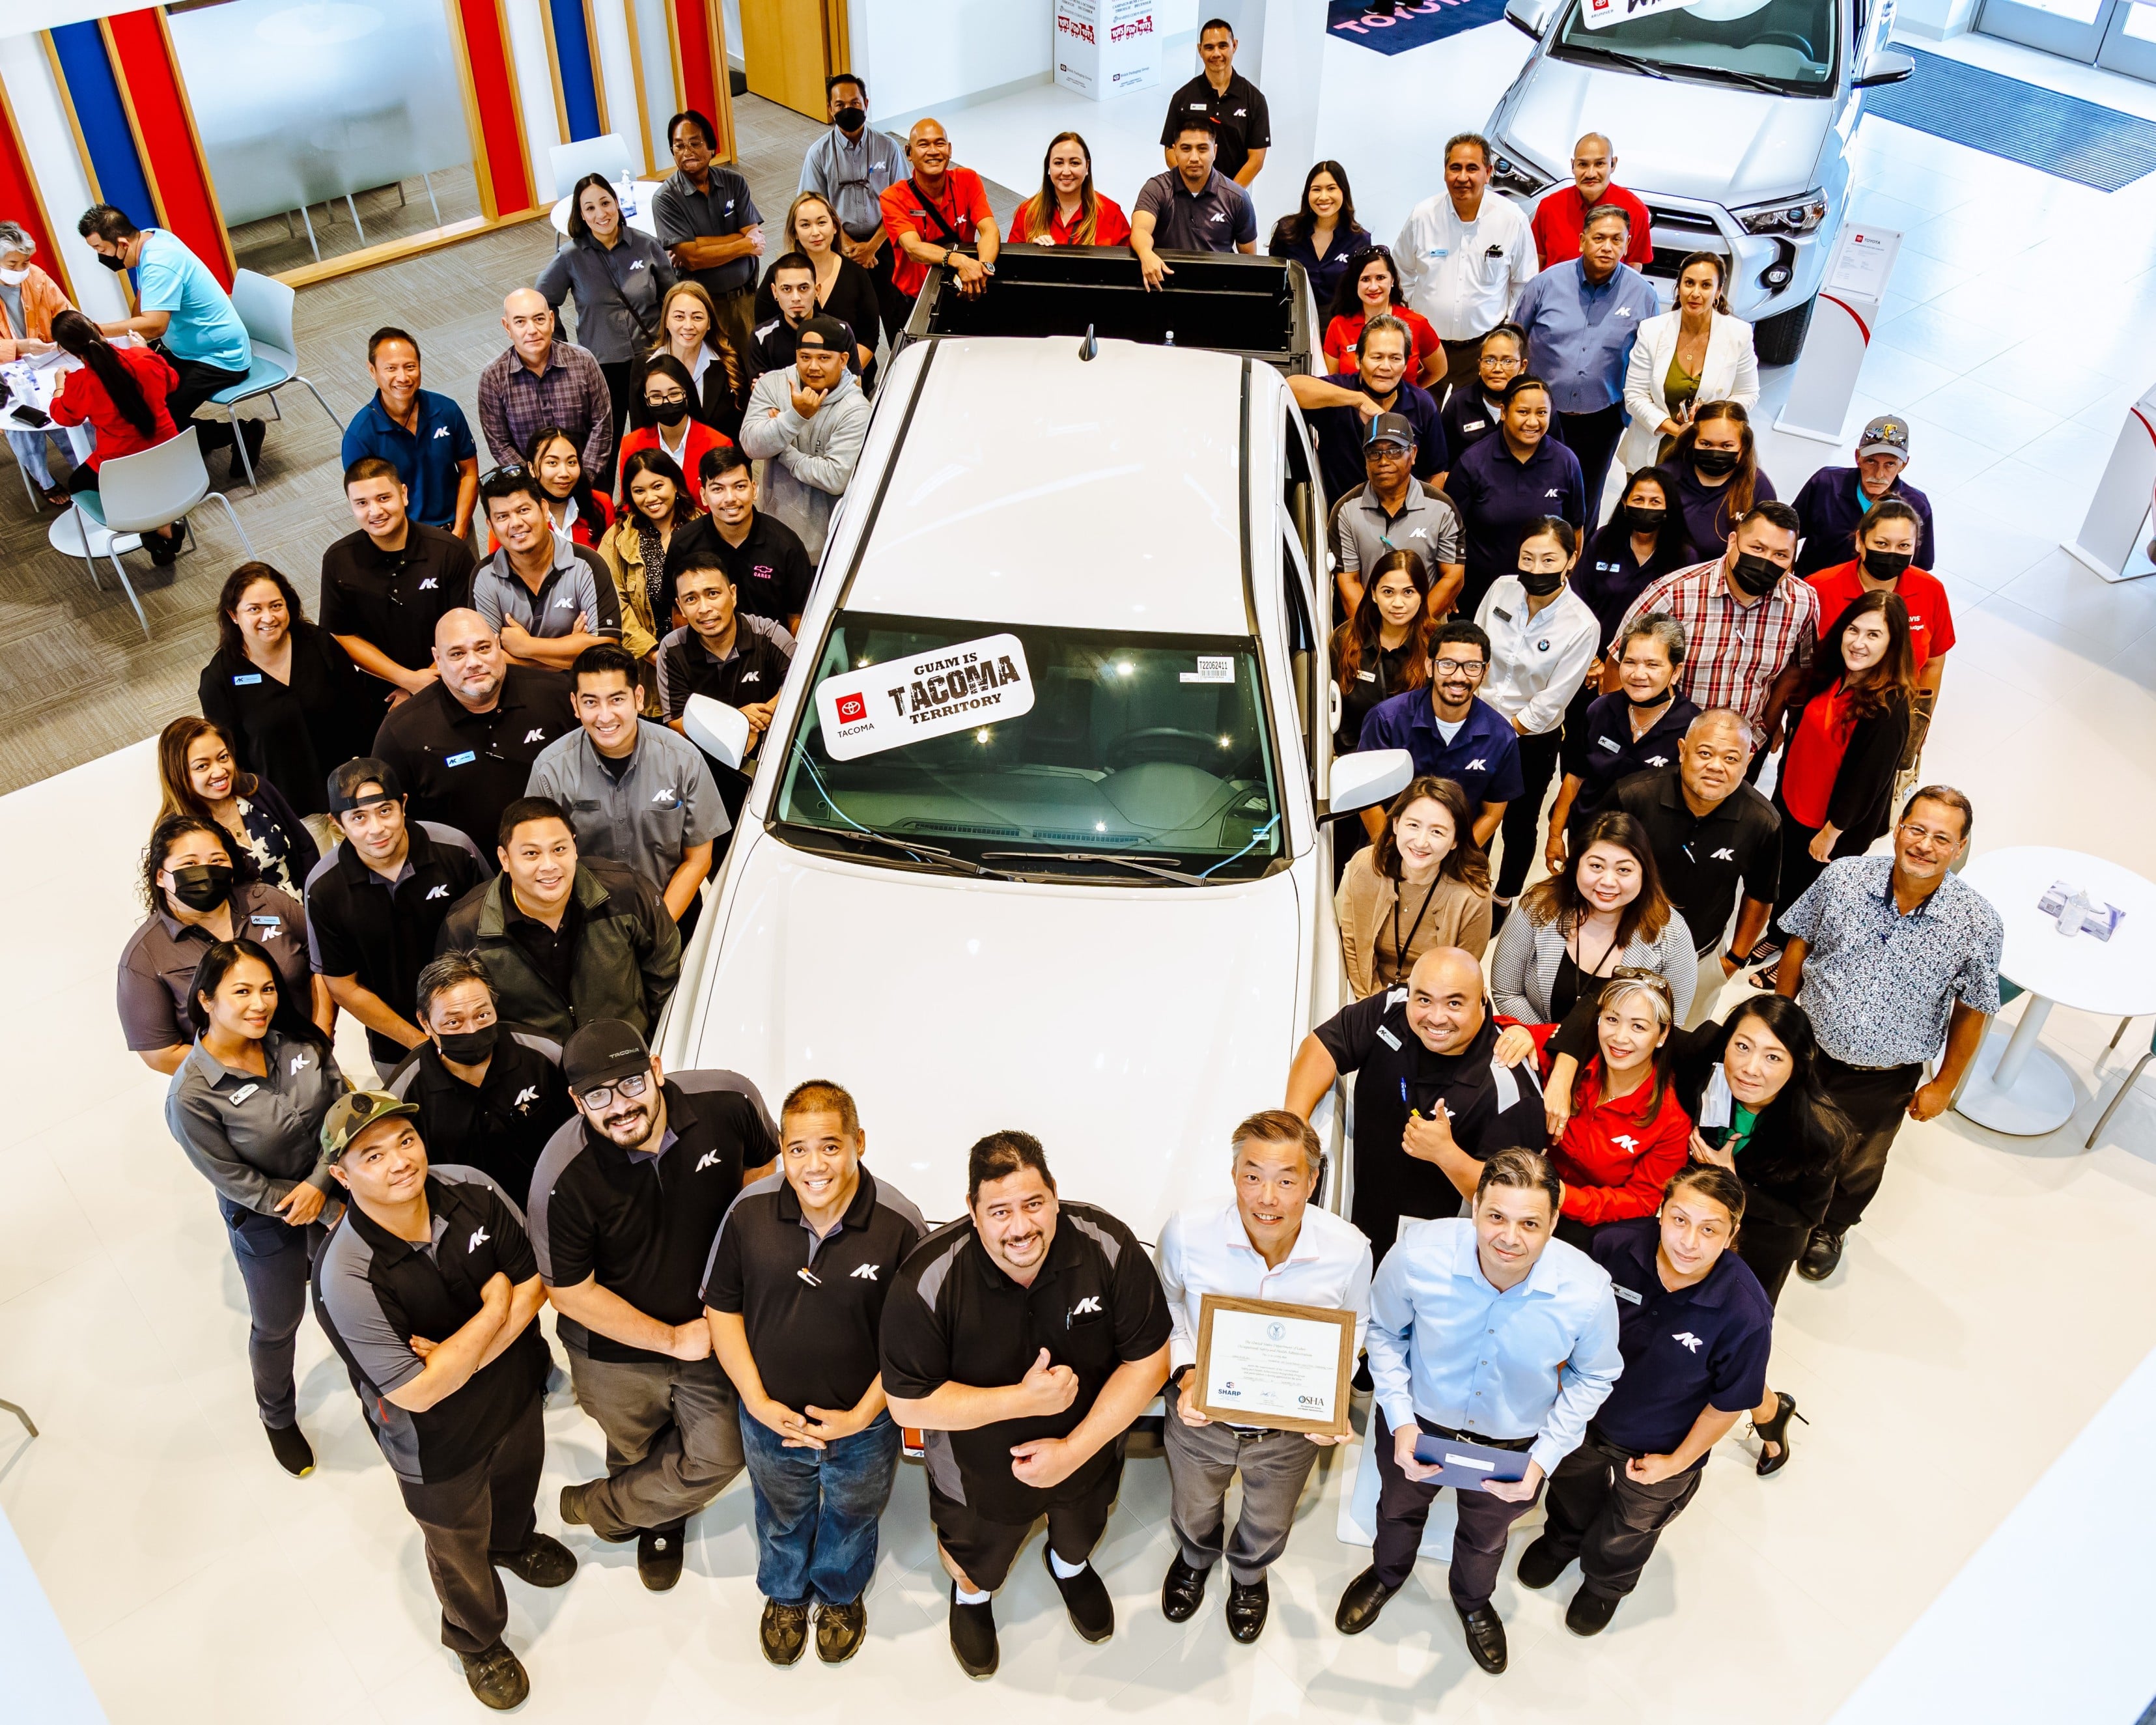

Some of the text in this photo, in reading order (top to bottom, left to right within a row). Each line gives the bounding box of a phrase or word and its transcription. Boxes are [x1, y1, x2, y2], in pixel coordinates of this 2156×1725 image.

[1059, 19, 1094, 40] TOYS FOR TOTS
[1112, 21, 1151, 38] TOYS FOR TOTS
[1211, 213, 1225, 222] AK
[1334, 253, 1349, 262] AK
[630, 260, 644, 270] AK
[1615, 307, 1631, 316] AK
[434, 427, 450, 438] AK
[1410, 527, 1427, 537] AK
[419, 578, 438, 589] AK
[554, 598, 573, 608] AK
[914, 652, 977, 675] GUAM IS
[742, 671, 759, 682] AK
[888, 655, 1021, 716] TACOMA
[910, 693, 1001, 724] TERRITORY
[524, 729, 545, 743] AK
[837, 723, 875, 738] TACOMA
[1465, 759, 1486, 770] AK
[1645, 756, 1668, 767] AK
[652, 789, 674, 802] AK
[1711, 848, 1734, 861] AK
[426, 884, 449, 900] AK
[262, 925, 282, 942] AK
[609, 1047, 639, 1058] TACOMA
[291, 1054, 310, 1076] AK
[514, 1086, 539, 1105] AK
[1611, 1135, 1639, 1153] AK
[696, 1149, 721, 1171] AK
[469, 1226, 490, 1254] AK
[850, 1264, 879, 1280] AK
[1074, 1297, 1102, 1315] AK
[1672, 1332, 1703, 1353] AK
[1298, 1395, 1324, 1406] OSHA
